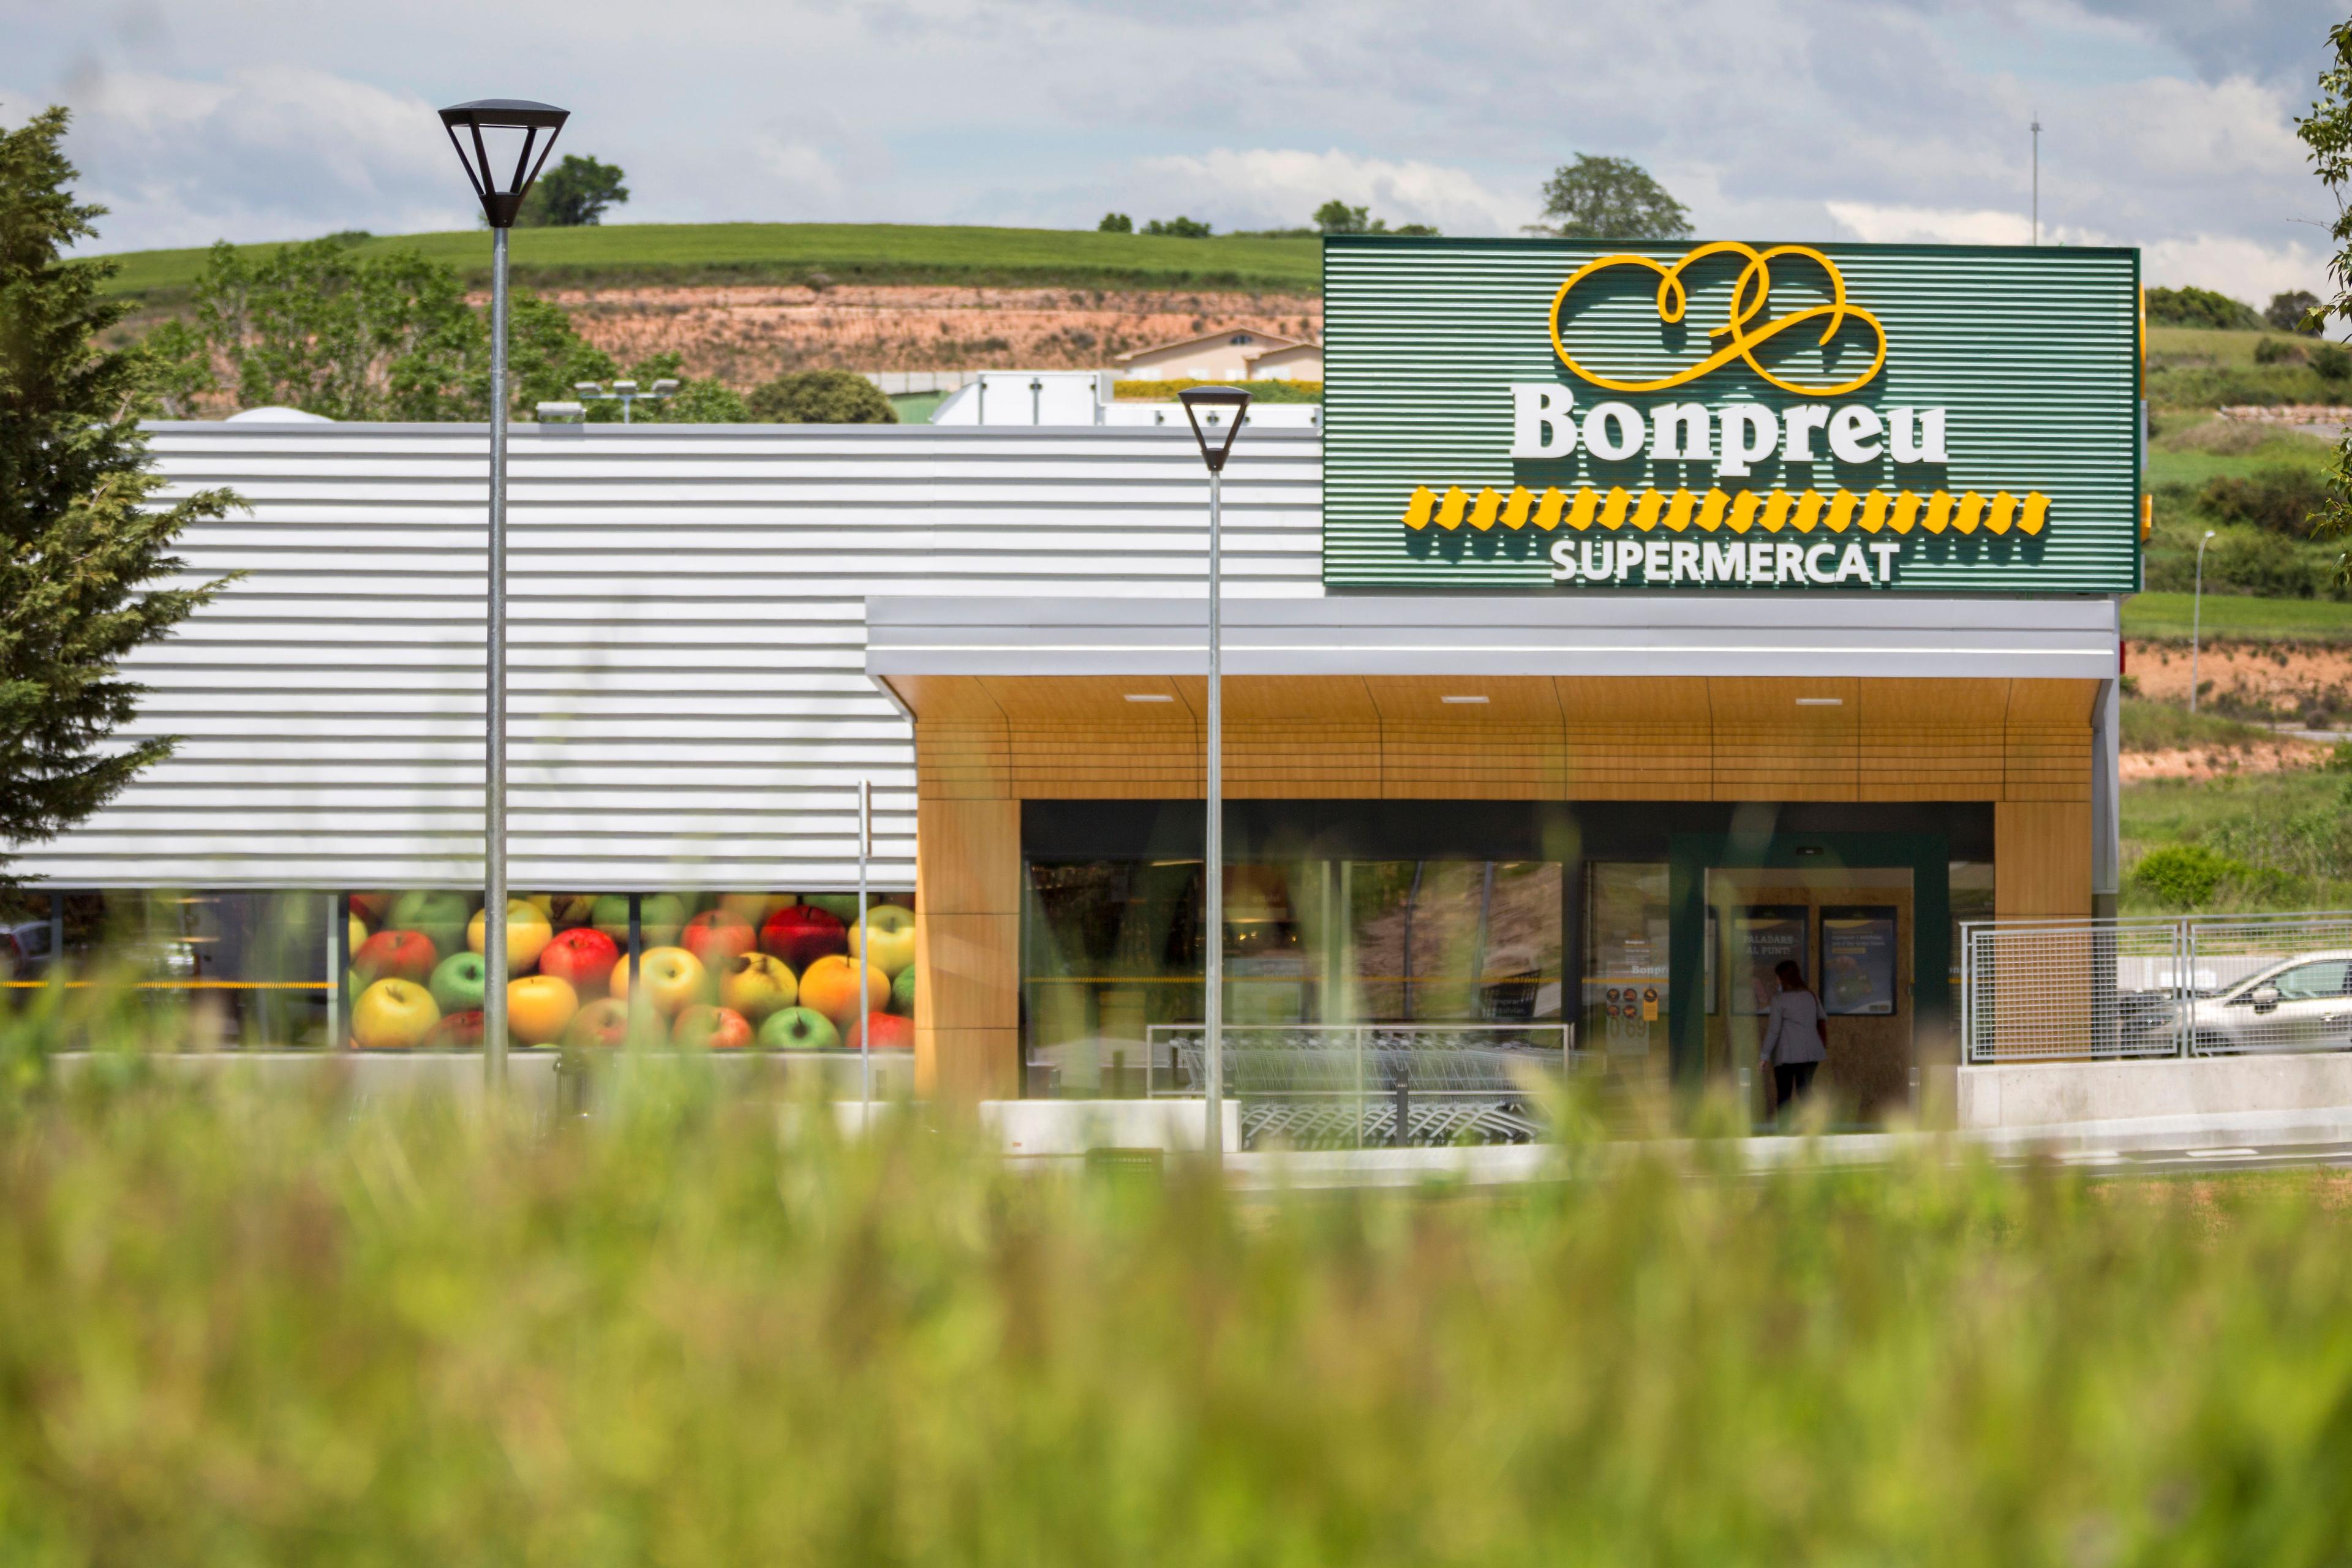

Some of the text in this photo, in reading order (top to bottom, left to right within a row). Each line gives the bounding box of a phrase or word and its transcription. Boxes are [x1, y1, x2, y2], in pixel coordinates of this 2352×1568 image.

[1510, 382, 1949, 477] Bonpreu
[1550, 540, 1900, 583] SUPERMERCAT
[1631, 965, 1668, 975] Bonpr
